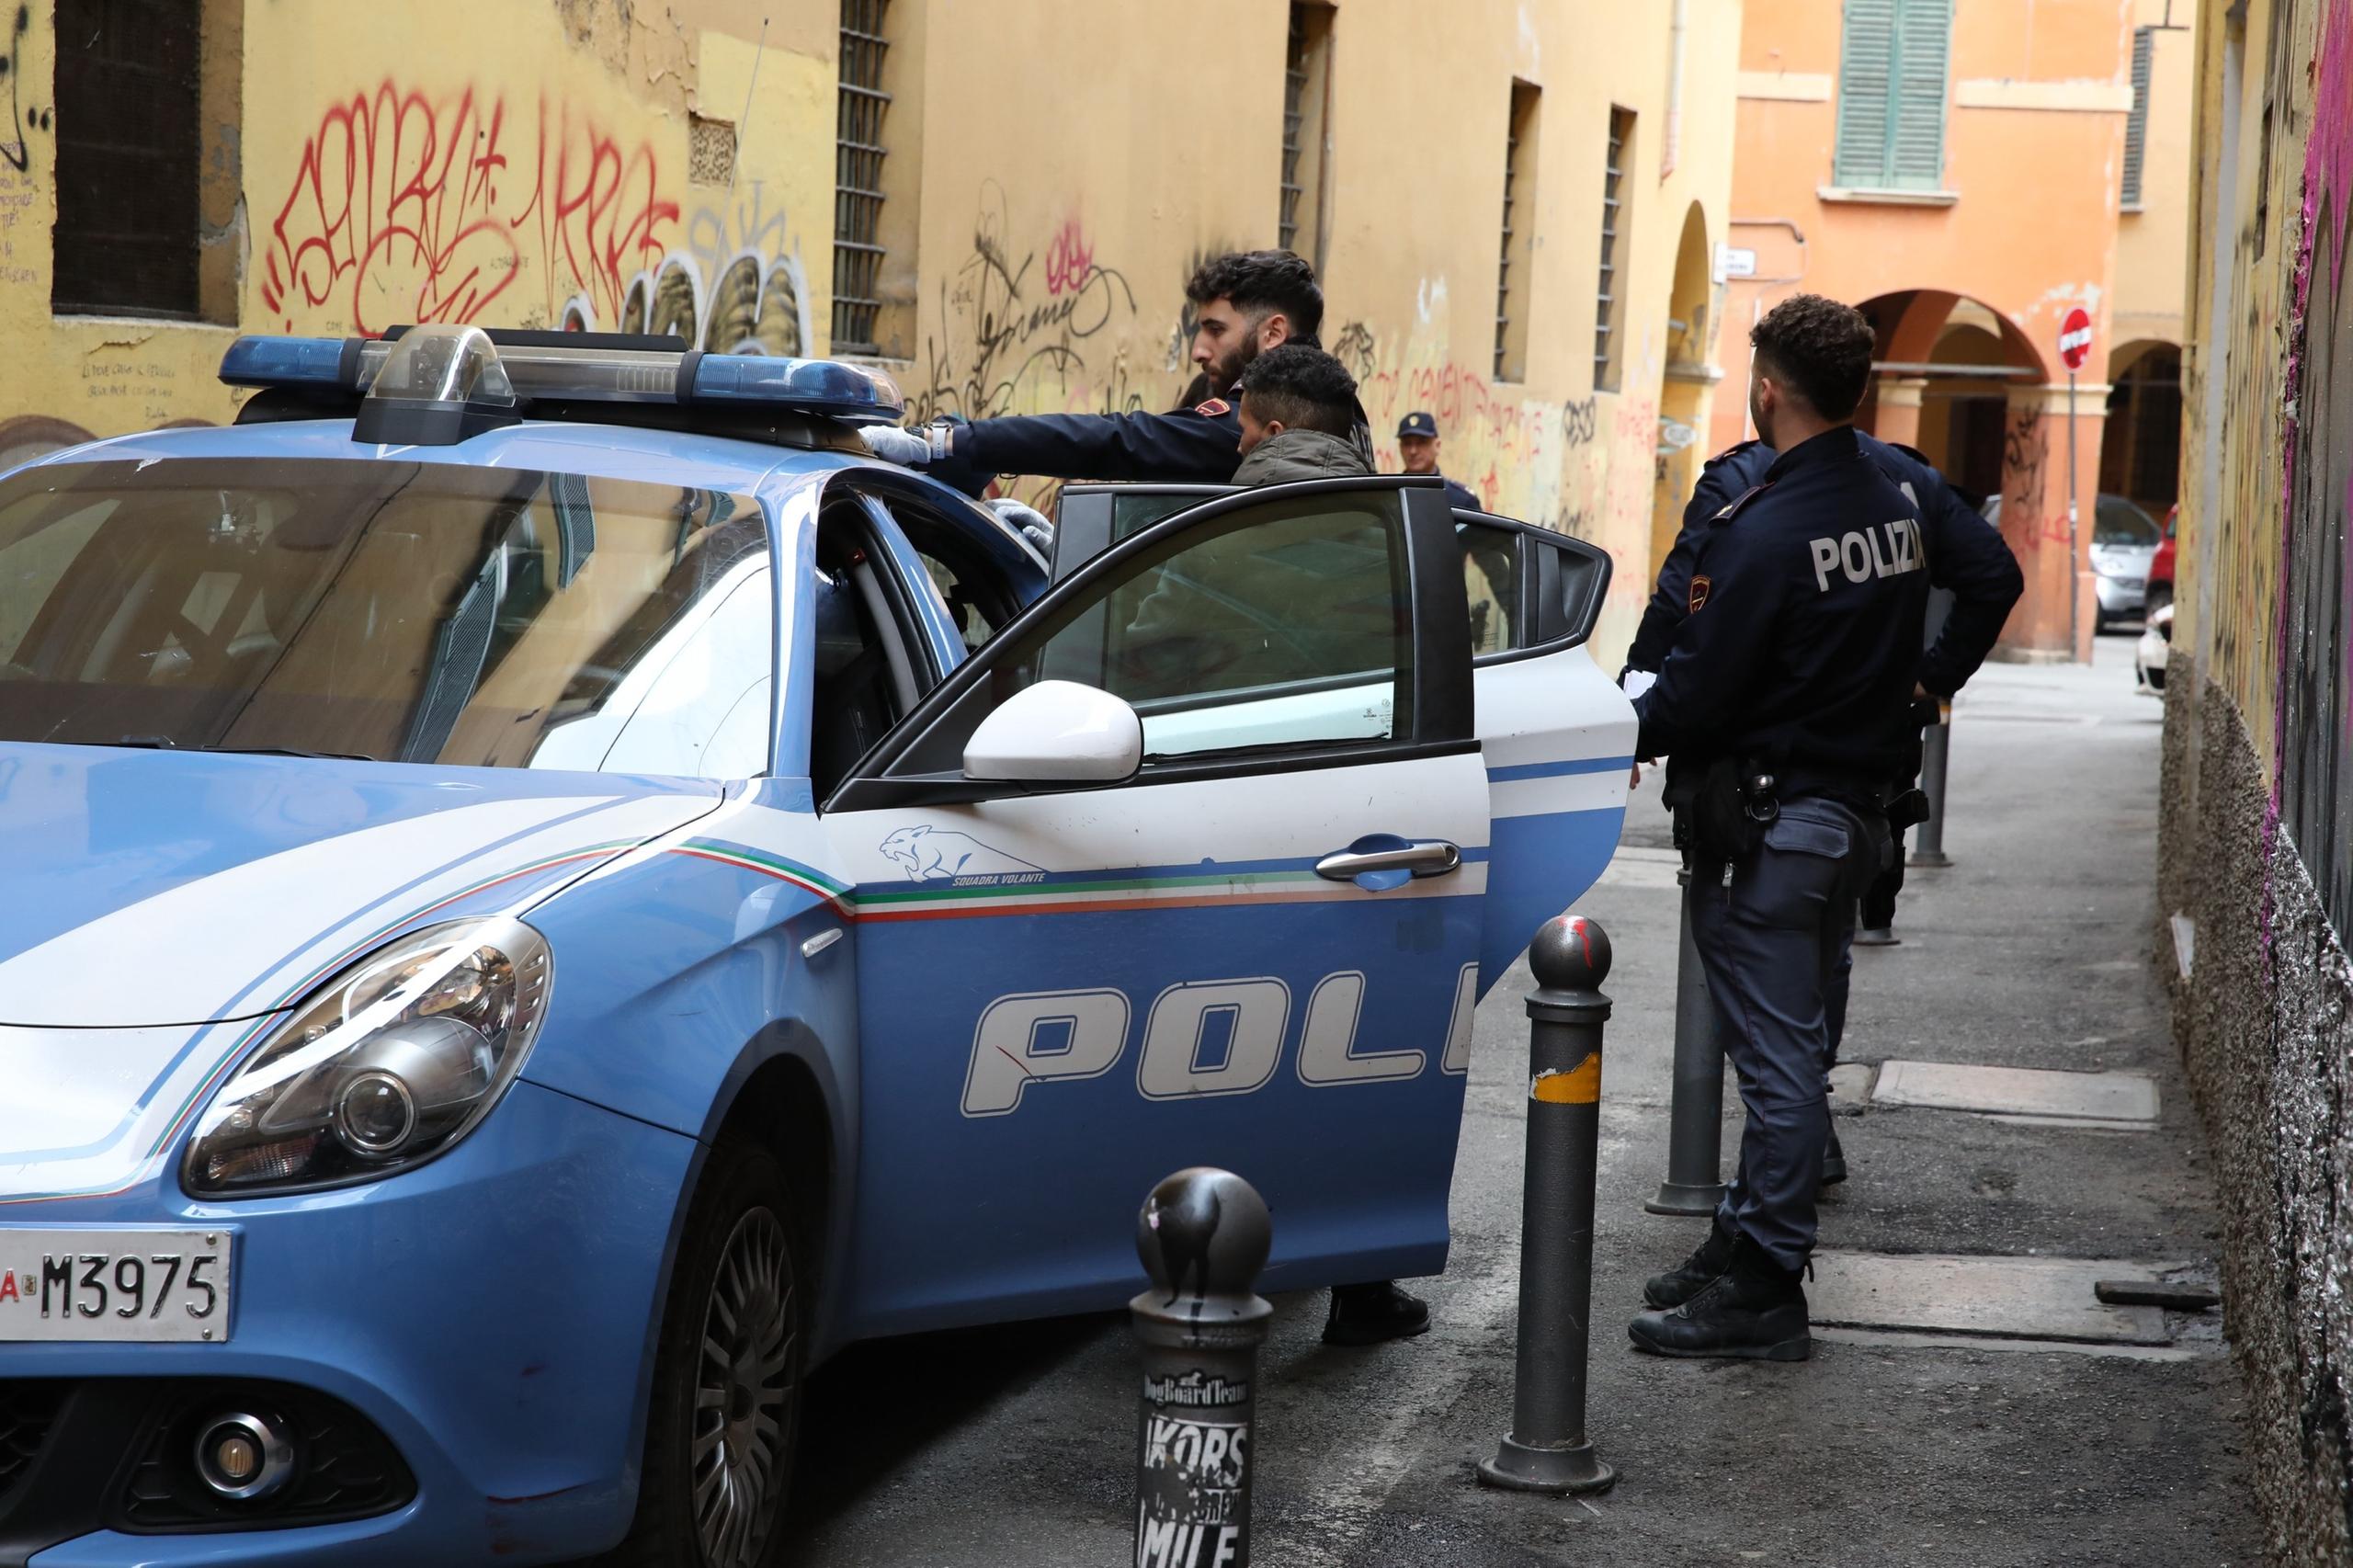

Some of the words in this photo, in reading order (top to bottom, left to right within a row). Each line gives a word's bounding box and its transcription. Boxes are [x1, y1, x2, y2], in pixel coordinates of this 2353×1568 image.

[1809, 518, 1927, 593] POLIZIA
[952, 874, 999, 887] SQUADRA
[1001, 872, 1045, 885] VOLANTE
[40, 1254, 218, 1319] M3975
[1149, 1419, 1247, 1488] KORS
